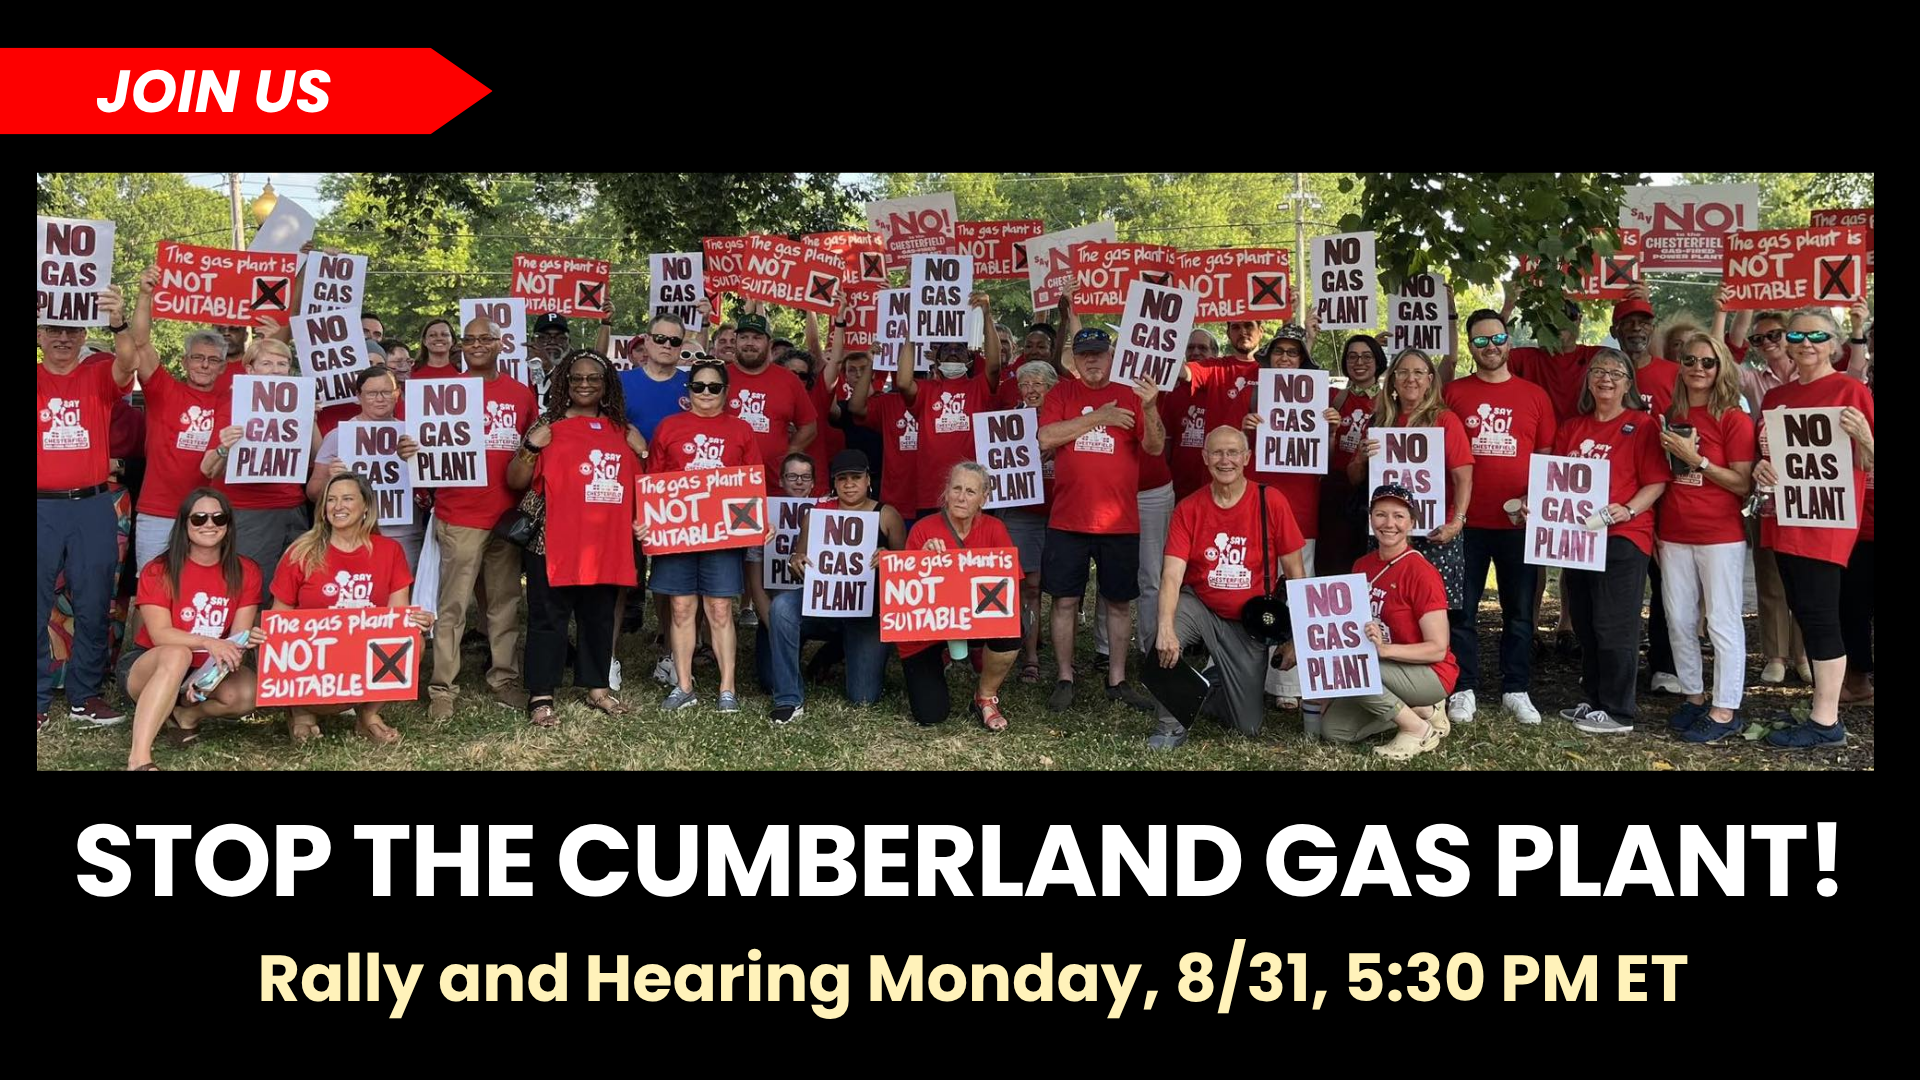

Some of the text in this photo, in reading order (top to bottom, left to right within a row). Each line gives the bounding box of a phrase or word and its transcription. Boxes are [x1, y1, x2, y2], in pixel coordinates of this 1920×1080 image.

[889, 208, 951, 236] NO!
[1652, 202, 1744, 232] NO!
[1813, 213, 1837, 227] The
[46, 223, 95, 256] NO
[803, 232, 882, 250] The gas plant is
[890, 237, 945, 251] CHESTERFIELD
[958, 223, 1042, 239] The gas plant is
[1623, 231, 1637, 245] is
[1645, 237, 1723, 248] CHESTERFIEL
[1728, 229, 1862, 257] The gas plant is
[706, 239, 744, 253] The gas
[750, 235, 838, 267] The gas plant
[1077, 245, 1099, 262] The
[1102, 248, 1131, 269] gas
[1134, 247, 1165, 265] plant
[1166, 248, 1175, 264] is
[1324, 237, 1360, 266] NO
[41, 260, 97, 288] GAS
[166, 245, 295, 278] The gas plant is
[319, 256, 354, 281] NO
[517, 255, 608, 275] The gas plant is
[663, 257, 691, 280] NO
[709, 254, 742, 272] NOT
[748, 254, 796, 279] NOT
[925, 258, 959, 281] NO
[1178, 250, 1288, 272] The gas plant is
[1729, 253, 1795, 279] NOT
[163, 271, 218, 293] NOT
[516, 272, 563, 294] NOT
[741, 277, 804, 301] SUITABLE
[1077, 267, 1129, 288] NOT
[1322, 270, 1363, 292] GAS
[1401, 274, 1434, 298] NO
[1725, 280, 1807, 301] SUITABLE
[154, 291, 252, 320] SUITABLE
[313, 283, 352, 303] GAS
[660, 284, 696, 302] GAS
[851, 292, 869, 308] gas
[922, 285, 960, 305] GAS
[1074, 289, 1126, 306] SUITABL
[1140, 288, 1182, 323] NO
[548, 313, 557, 321] P
[918, 310, 965, 336] PLANT
[1318, 296, 1368, 324] PLANT
[1398, 301, 1437, 321] GAS
[306, 315, 348, 346] NO
[1131, 322, 1177, 352] GAS
[1395, 325, 1442, 349] PLANT
[311, 345, 357, 372] GAS
[1119, 350, 1176, 386] PLANT
[251, 381, 298, 412] NO
[424, 384, 467, 416] NO
[1274, 374, 1313, 403] NO
[500, 403, 515, 411] SAY
[246, 418, 298, 442] GAS
[988, 414, 1024, 443] NO
[1270, 409, 1316, 432] GAS
[1784, 414, 1832, 447] NO
[356, 426, 397, 456] NO
[420, 422, 471, 446] GAS
[604, 453, 621, 461] SAY
[989, 446, 1029, 469] GAS
[1265, 437, 1320, 467] PLANT
[1386, 433, 1427, 463] NO
[236, 447, 301, 477] PLANT
[418, 452, 477, 481] PLANT
[1786, 453, 1838, 480] GAS
[637, 466, 762, 498] The gas plant is
[989, 472, 1036, 502] PLANT
[1546, 461, 1592, 493] NO
[643, 492, 711, 525] NOT
[1542, 497, 1594, 525] GAS
[1784, 486, 1845, 521] PLANT
[643, 521, 729, 548] SUITABLE
[824, 515, 863, 546] NO
[1230, 536, 1247, 545] SAY
[1534, 527, 1598, 563] PLANT
[819, 551, 863, 576] GAS
[882, 551, 1012, 577] The gas plant is
[353, 573, 371, 581] SAY
[210, 596, 229, 606] SAY
[812, 580, 866, 611] PLANT
[885, 576, 945, 606] NOT
[1305, 582, 1352, 618] NO
[267, 610, 400, 641] The gas plant
[882, 606, 972, 631] SUITABLE
[1307, 622, 1361, 651] GAS
[263, 637, 338, 674] NOT
[261, 673, 364, 698] SUITABLE
[1307, 654, 1371, 691] PLANT
